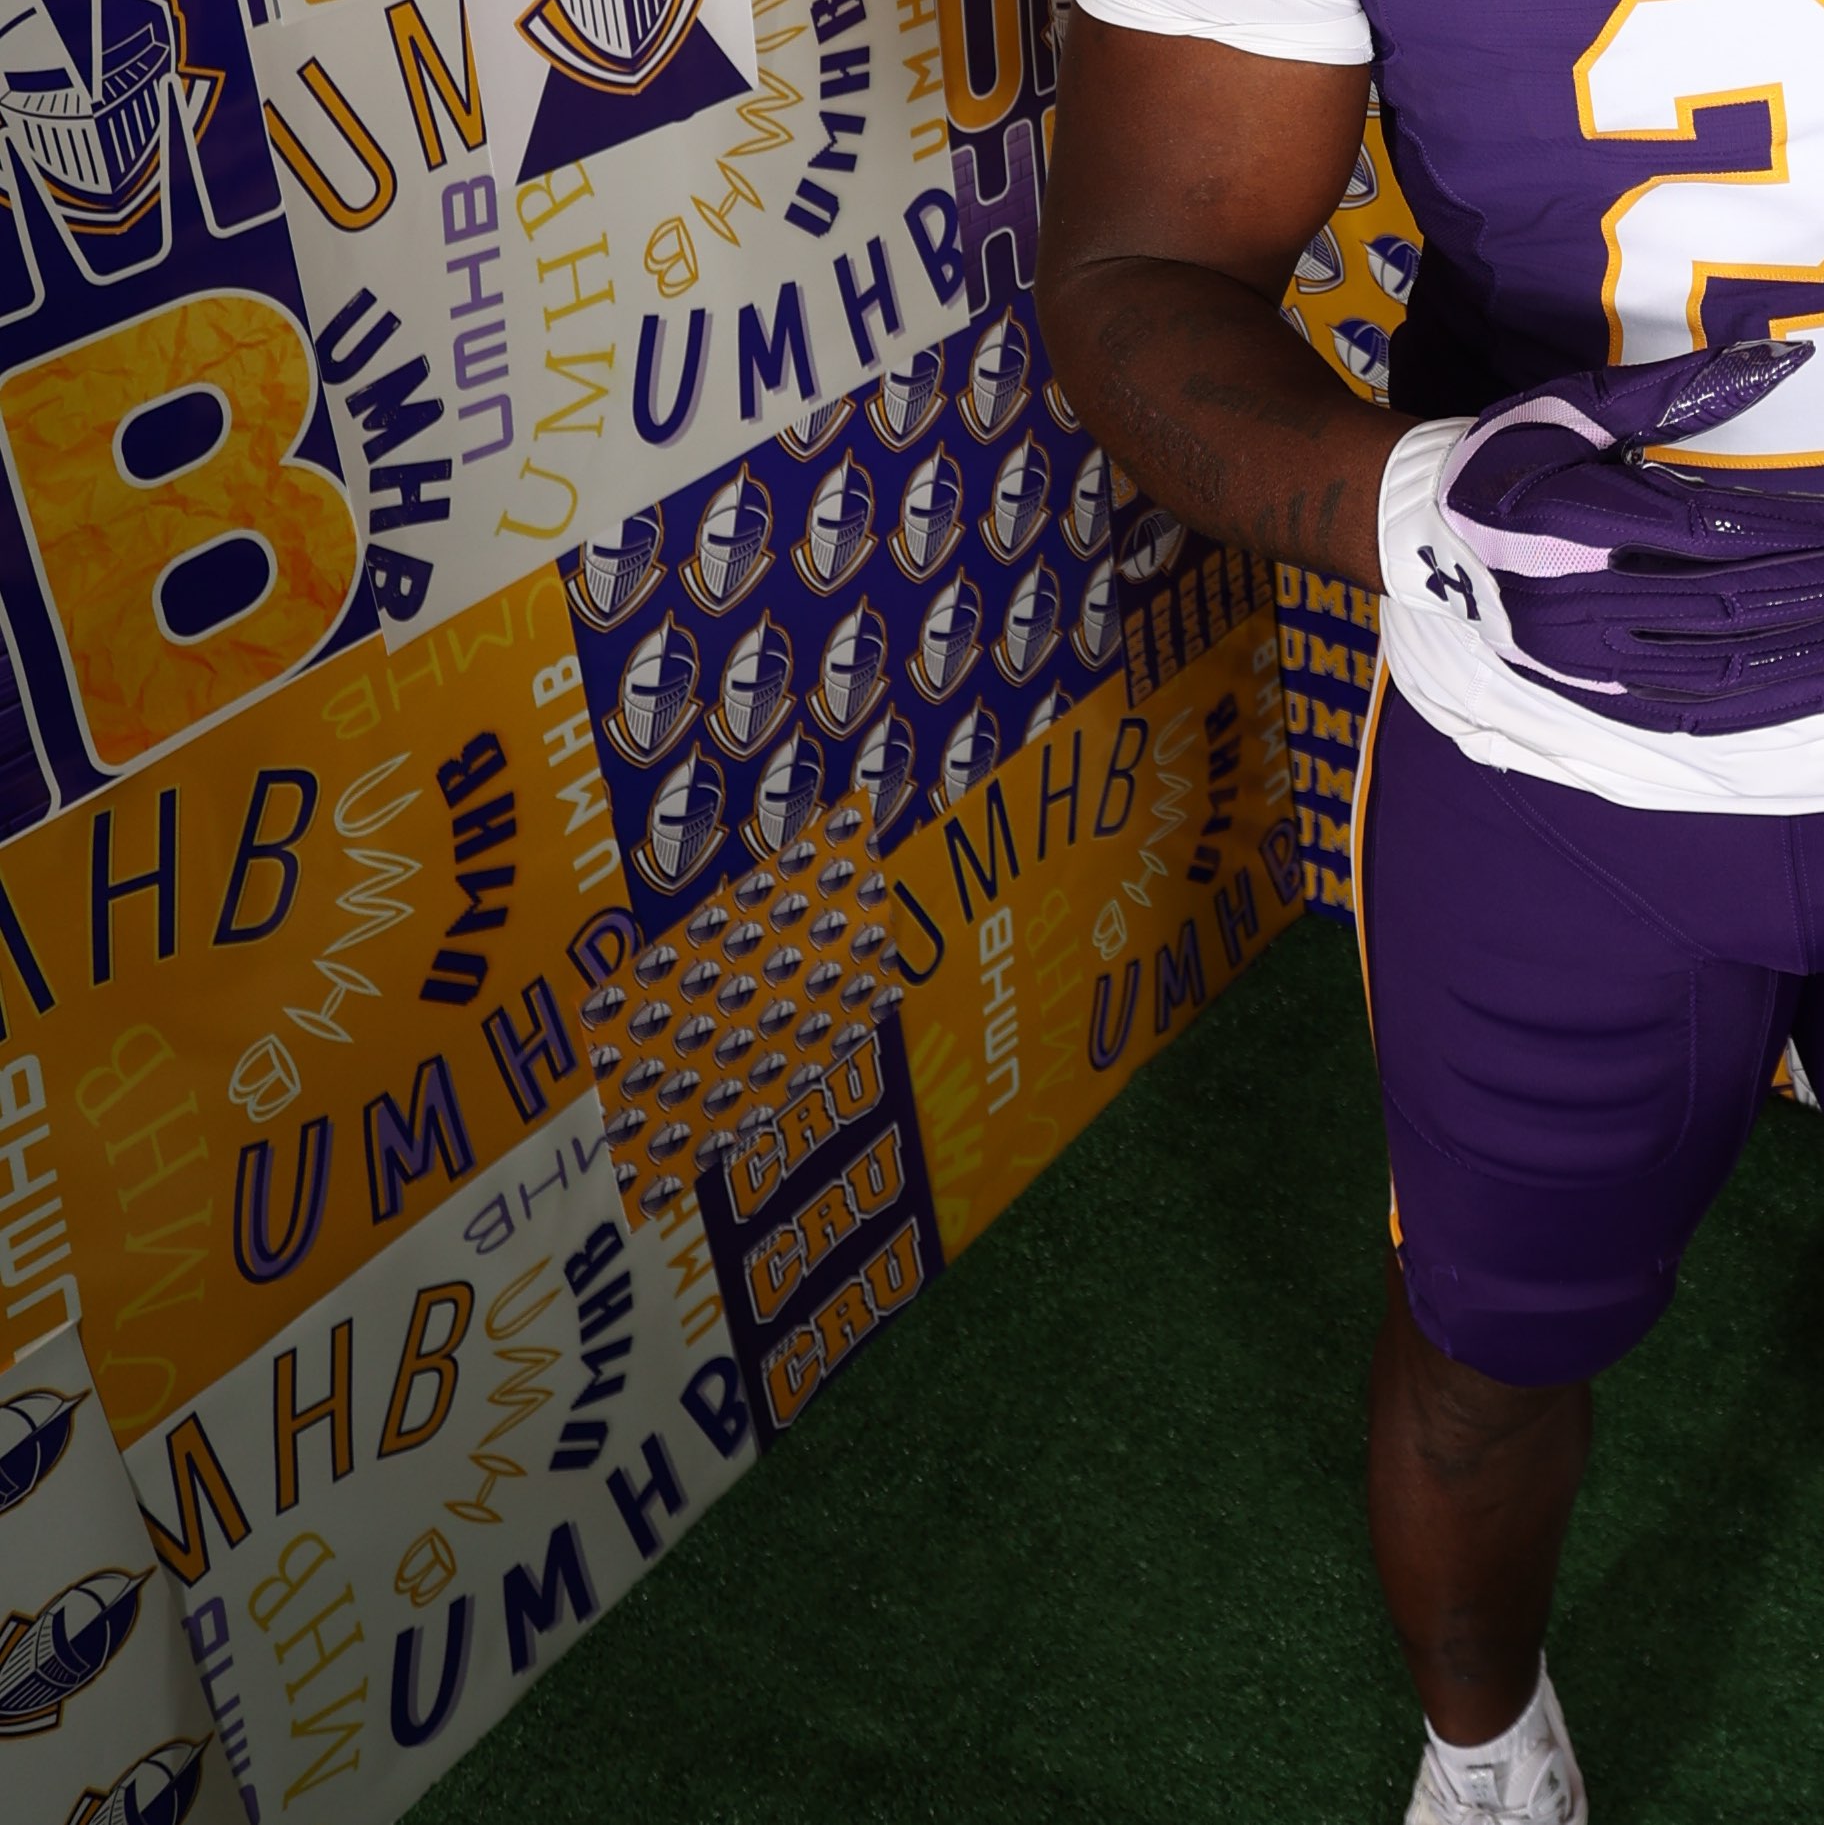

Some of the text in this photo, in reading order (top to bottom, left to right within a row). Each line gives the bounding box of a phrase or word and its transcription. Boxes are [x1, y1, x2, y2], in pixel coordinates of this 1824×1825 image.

[633, 186, 966, 447] UMHB
[1275, 562, 1380, 633] UMH
[419, 730, 517, 1006] UMHB
[896, 716, 1148, 987] UMHB
[723, 1030, 884, 1224] CRU
[744, 1123, 905, 1325] CRU
[550, 1222, 634, 1471] UMHB
[762, 1216, 924, 1429] CRU
[390, 1356, 748, 1748] UMHB
